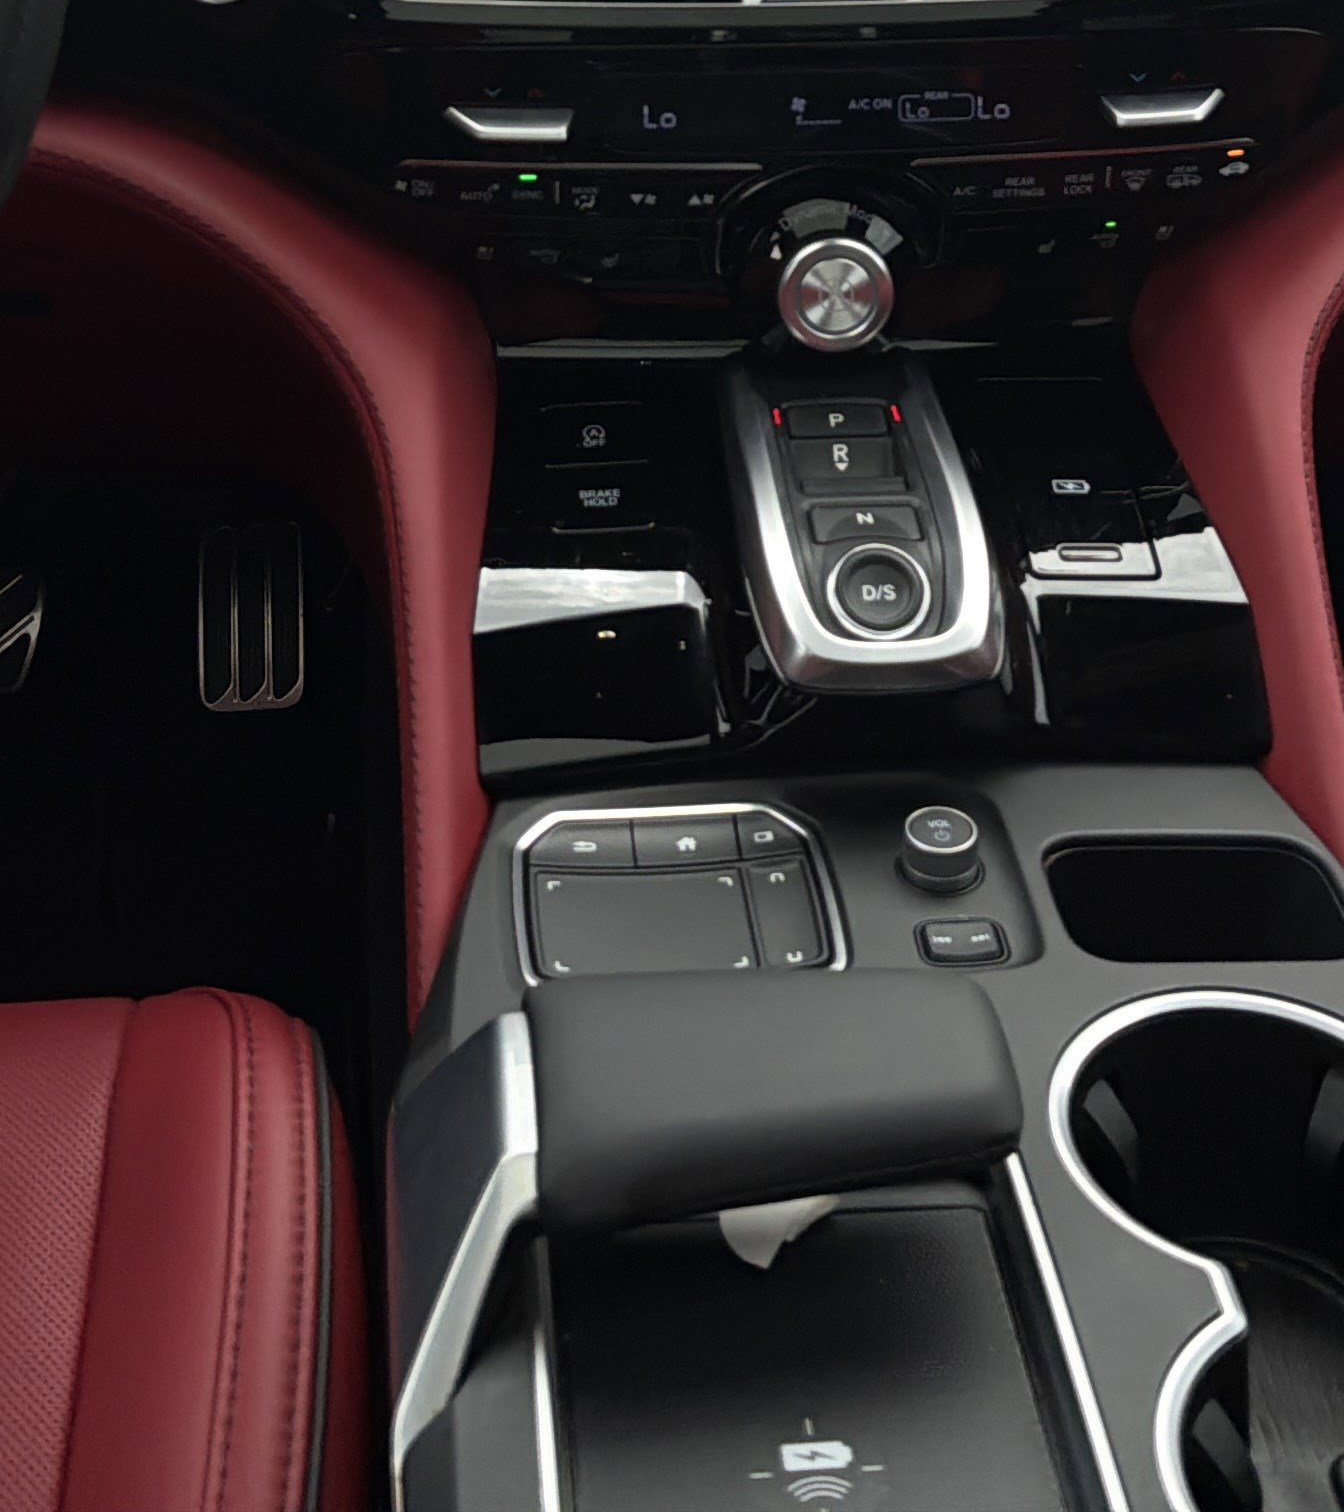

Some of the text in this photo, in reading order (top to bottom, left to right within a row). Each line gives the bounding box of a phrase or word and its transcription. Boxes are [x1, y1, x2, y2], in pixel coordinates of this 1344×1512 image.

[642, 95, 1011, 130] Lo A/C ON Lo Lo
[1004, 176, 1036, 187] REAR
[1064, 173, 1094, 184] REAR
[952, 185, 976, 197] A/C
[828, 412, 845, 428] P
[832, 443, 850, 463] R
[578, 488, 621, 499] BRAKE
[583, 496, 618, 507] HOLD
[855, 512, 875, 525] N
[861, 584, 897, 602] D/S
[926, 818, 951, 828] VOL
